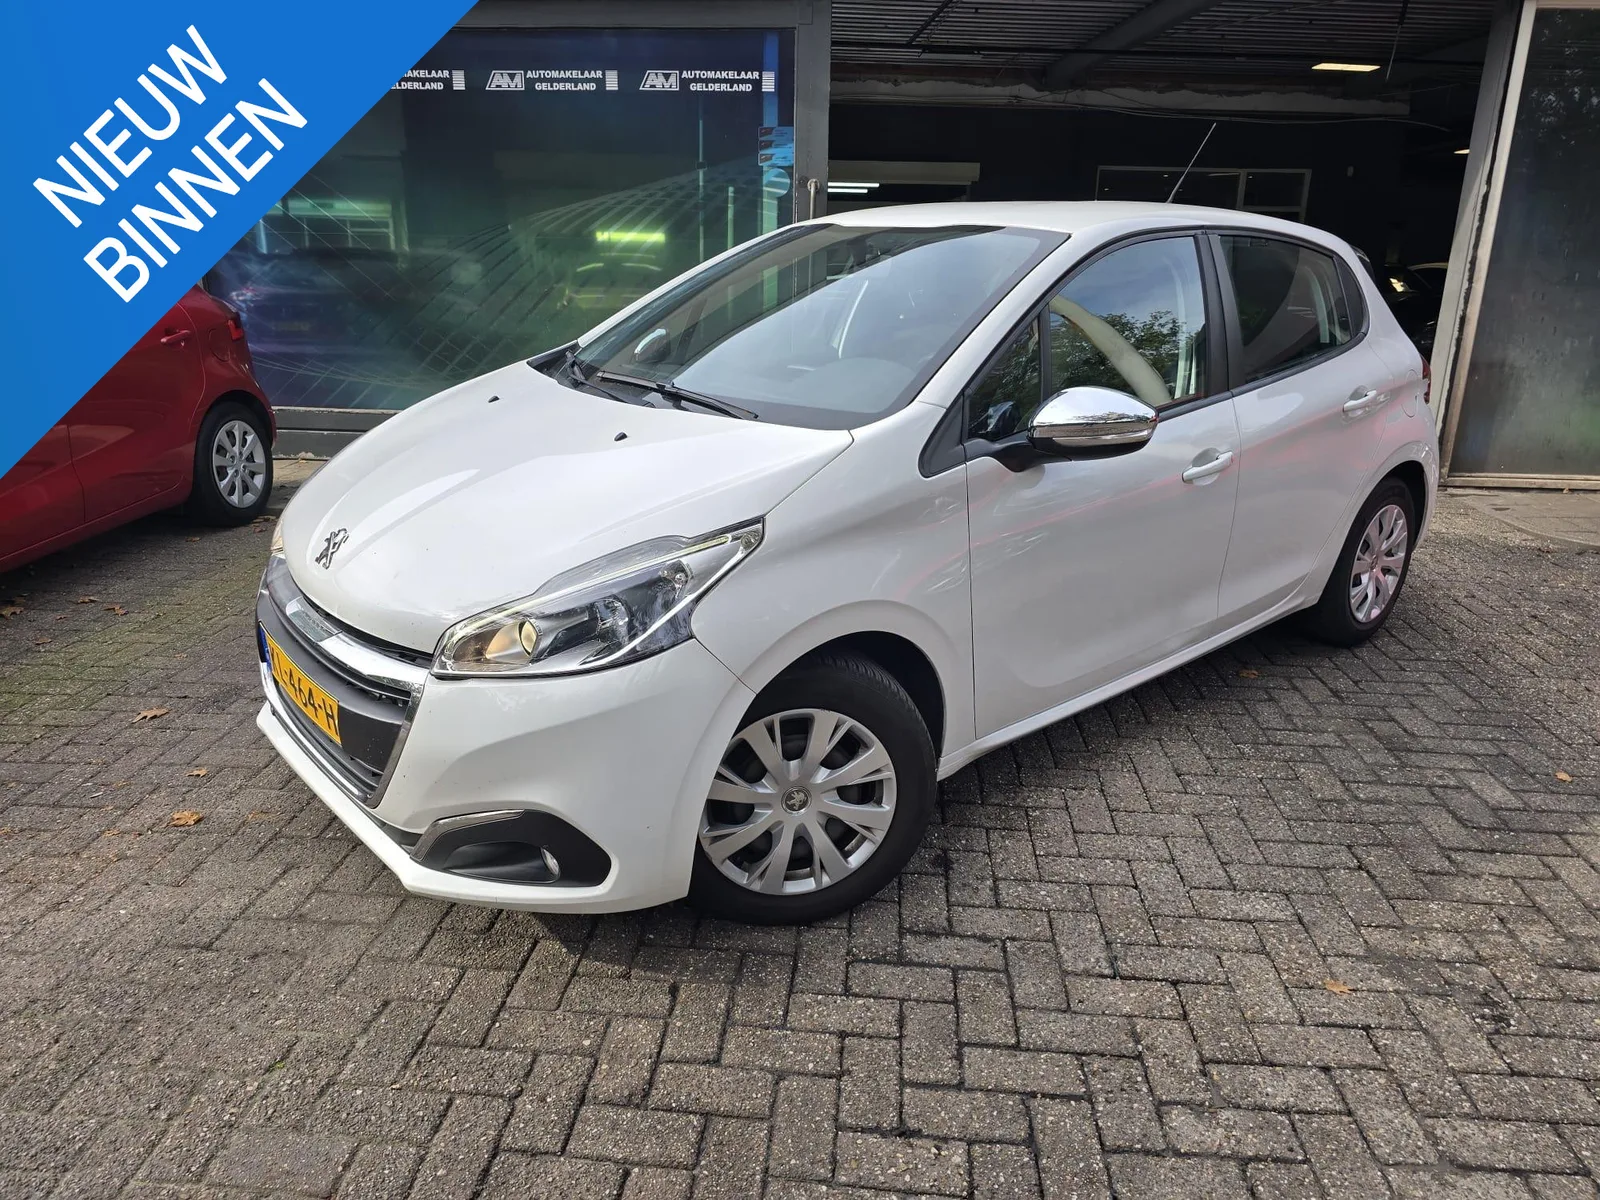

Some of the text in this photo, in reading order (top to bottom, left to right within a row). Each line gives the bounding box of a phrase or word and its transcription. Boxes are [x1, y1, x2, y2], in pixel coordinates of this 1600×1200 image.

[403, 69, 450, 78] AKELAAR
[526, 70, 603, 79] AUTOMAKELAAR
[681, 70, 760, 80] AUTOMAKELAAR
[534, 82, 597, 91] GELDERLAND
[689, 82, 753, 92] GELDERLAND
